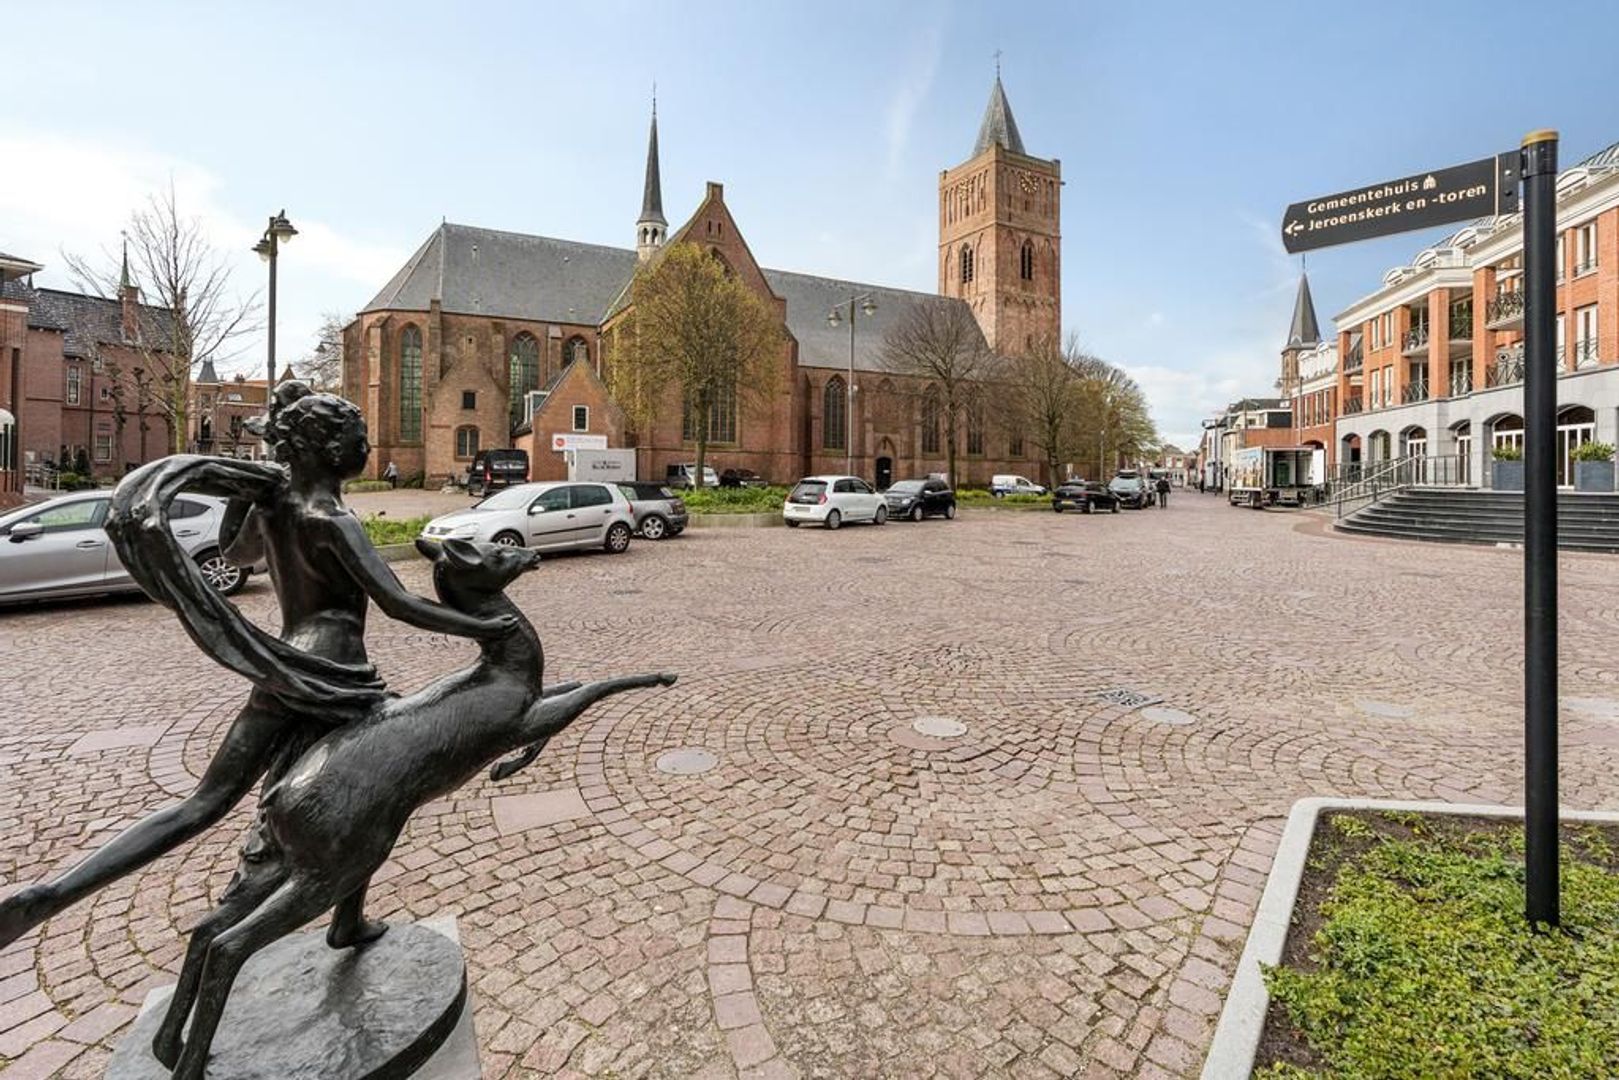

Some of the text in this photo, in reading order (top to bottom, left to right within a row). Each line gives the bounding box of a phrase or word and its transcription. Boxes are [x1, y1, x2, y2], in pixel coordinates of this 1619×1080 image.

[1307, 180, 1419, 214] Gemeentehuis
[1308, 183, 1487, 231] Jeroenskerk en -toren
